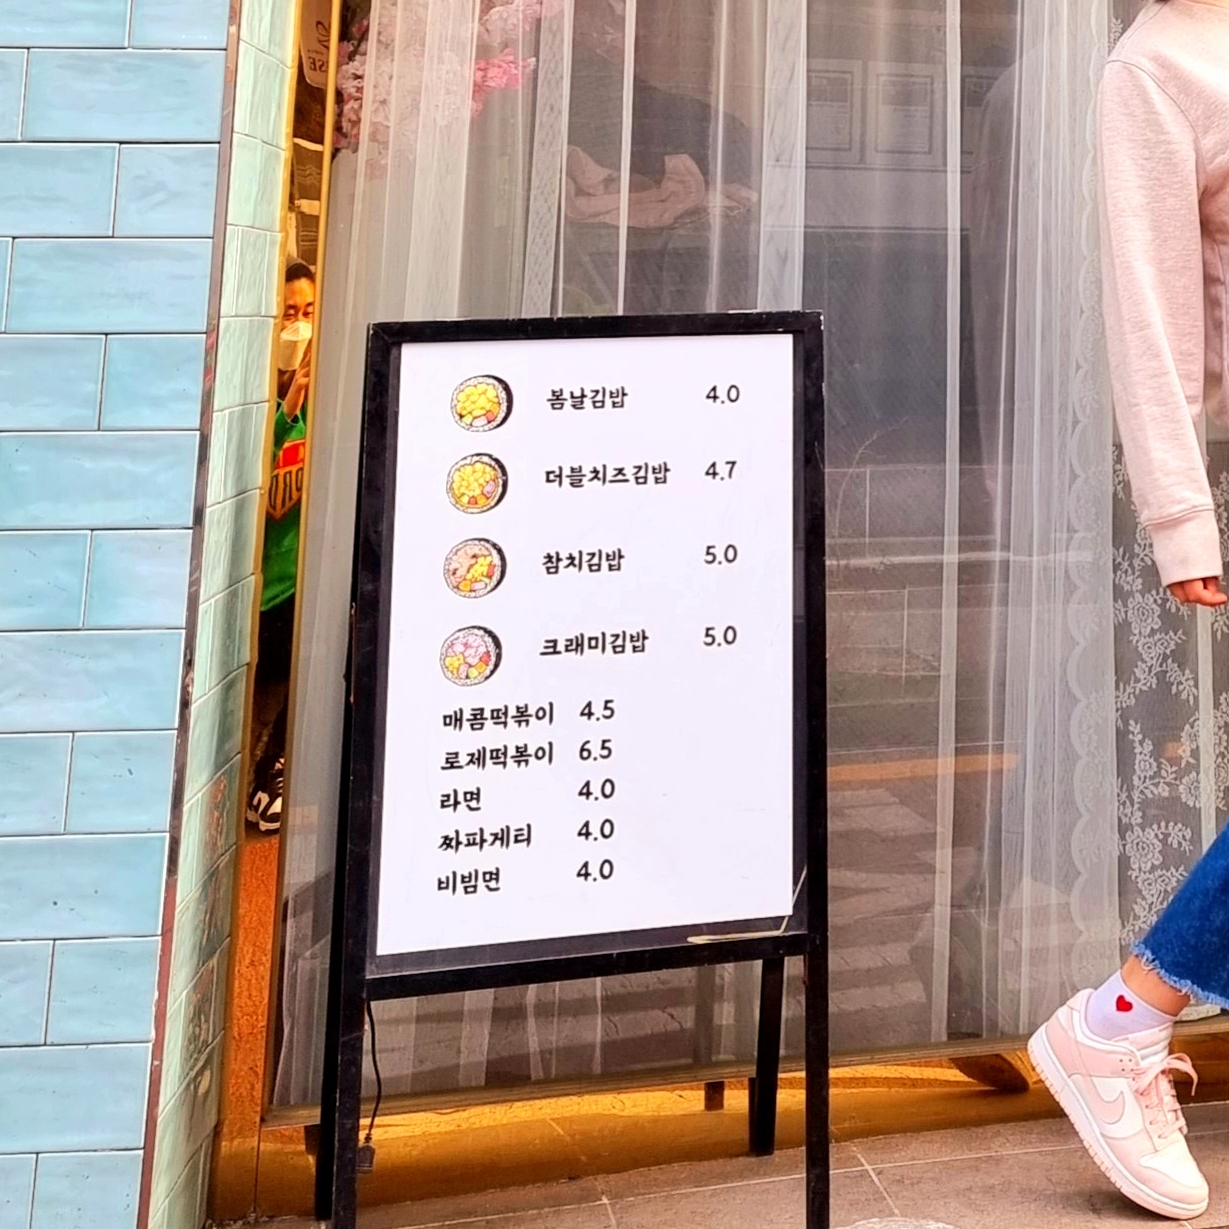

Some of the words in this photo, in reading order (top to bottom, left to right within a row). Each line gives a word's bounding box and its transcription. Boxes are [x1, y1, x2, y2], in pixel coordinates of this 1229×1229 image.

[546, 386, 628, 411] 봄날김밥
[705, 384, 740, 404] 4.0
[545, 461, 671, 489] 더블치즈김밥
[704, 460, 737, 481] 4.7
[542, 548, 625, 575] 참치김밥
[704, 544, 738, 565] 5.0
[539, 629, 649, 656] 크래미김밥
[703, 625, 737, 647] 5.0
[442, 701, 554, 732] 매콤떡볶이
[579, 699, 615, 722] 4.5
[440, 741, 554, 771] 로제떡볶이
[579, 738, 613, 761] 6.5
[440, 786, 482, 813] 라면
[577, 778, 616, 801] 4.0
[438, 823, 532, 853] 짜파게티
[577, 818, 615, 842] 4.0
[437, 866, 501, 895] 비빔면
[576, 858, 614, 882] 4.0
